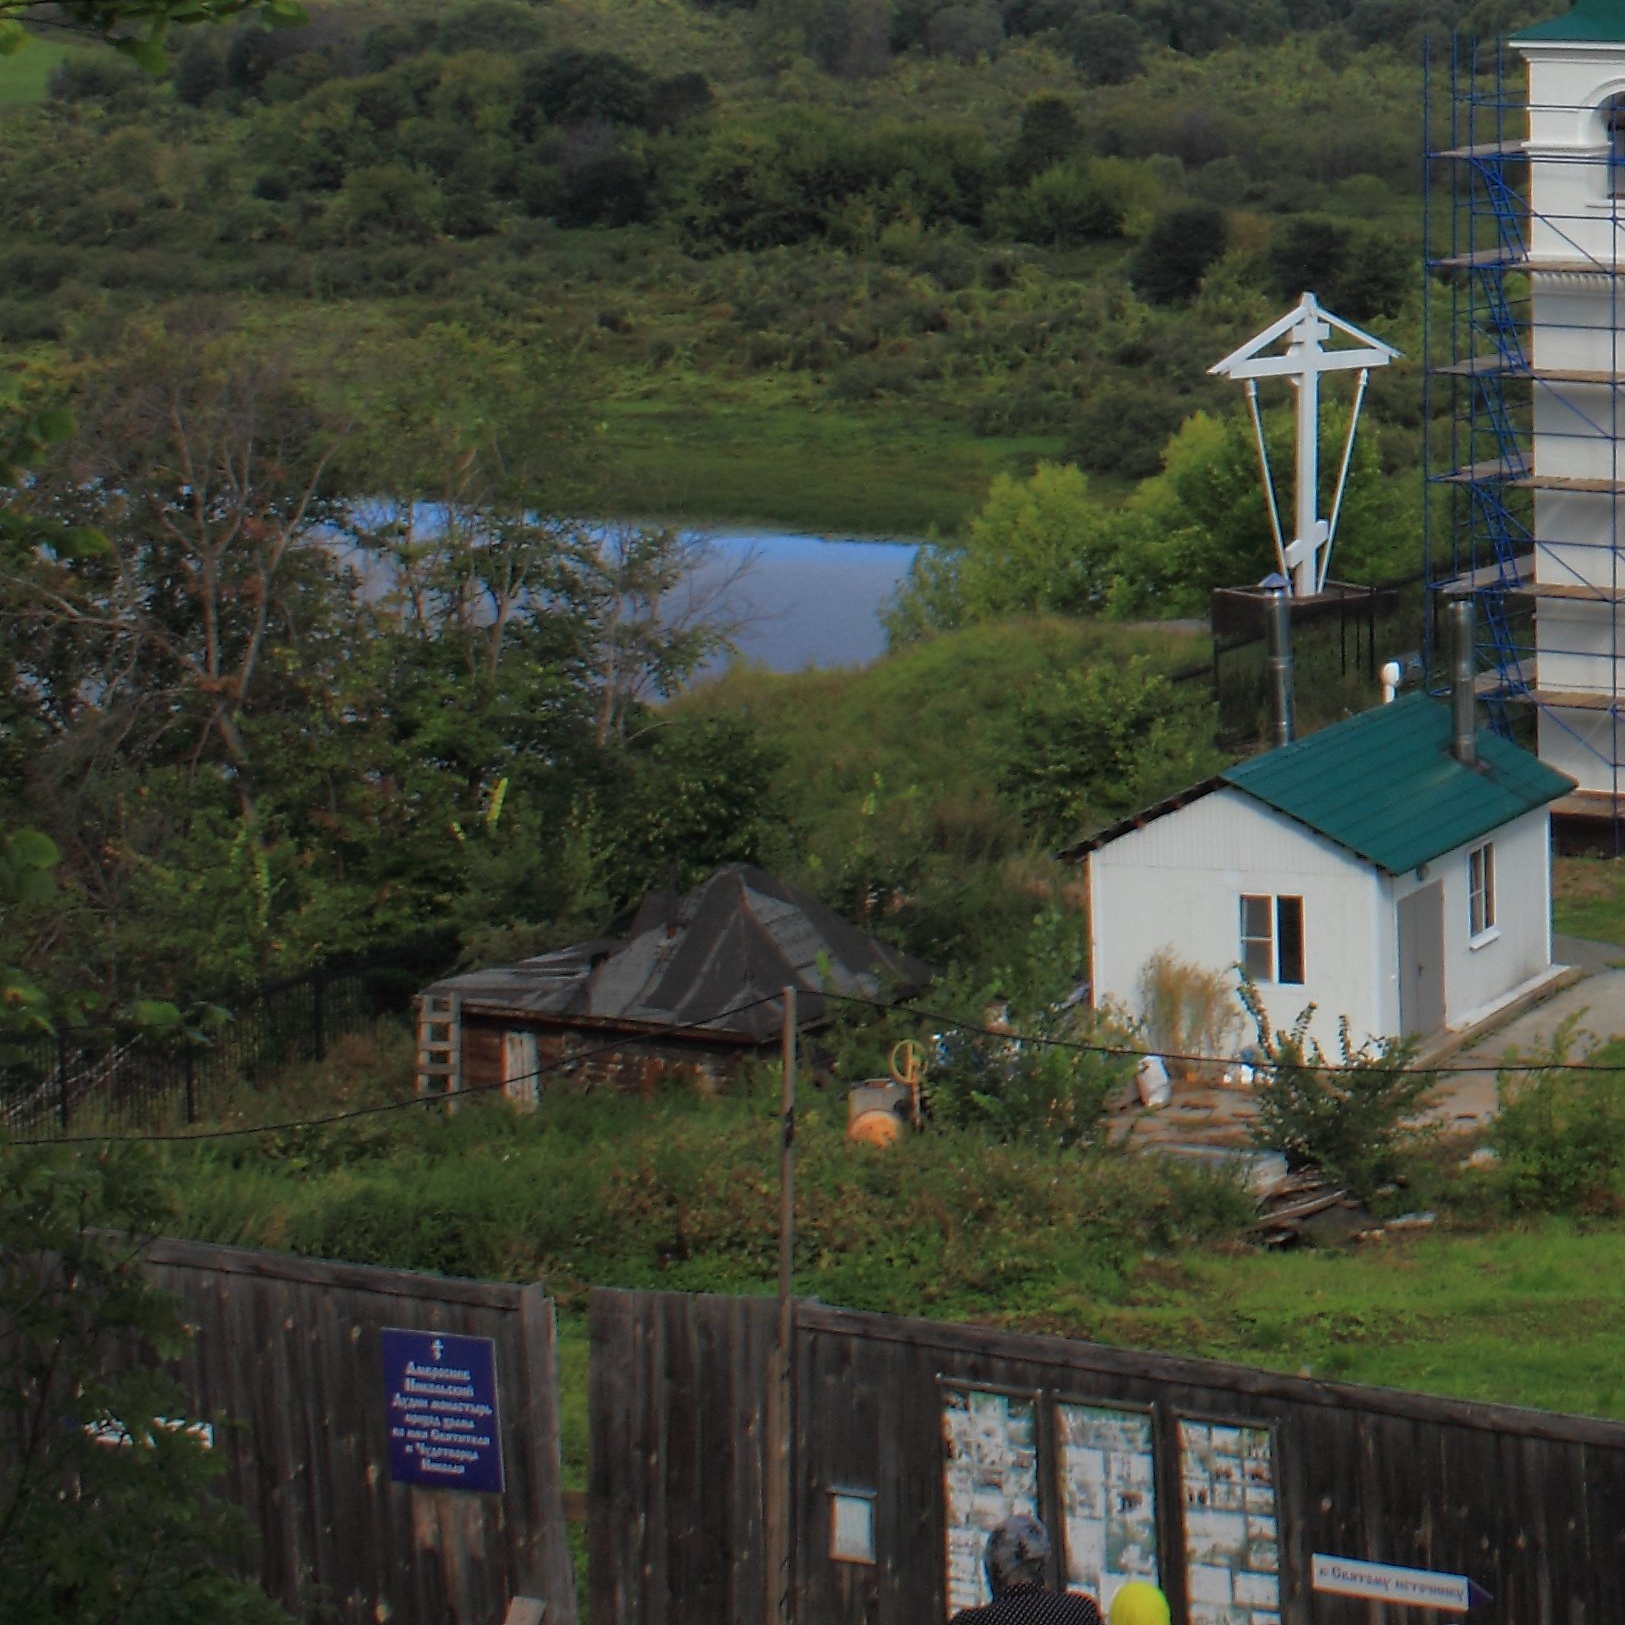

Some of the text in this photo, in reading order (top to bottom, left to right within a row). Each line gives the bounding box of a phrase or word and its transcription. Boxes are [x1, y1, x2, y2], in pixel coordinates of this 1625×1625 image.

[429, 1399, 493, 1417] монастырь
[430, 1429, 490, 1445] Святителя
[415, 1442, 479, 1462] Чудотворца
[421, 1458, 466, 1474] Николая
[1331, 1566, 1391, 1591] Святому
[1395, 1578, 1465, 1602] источнику
